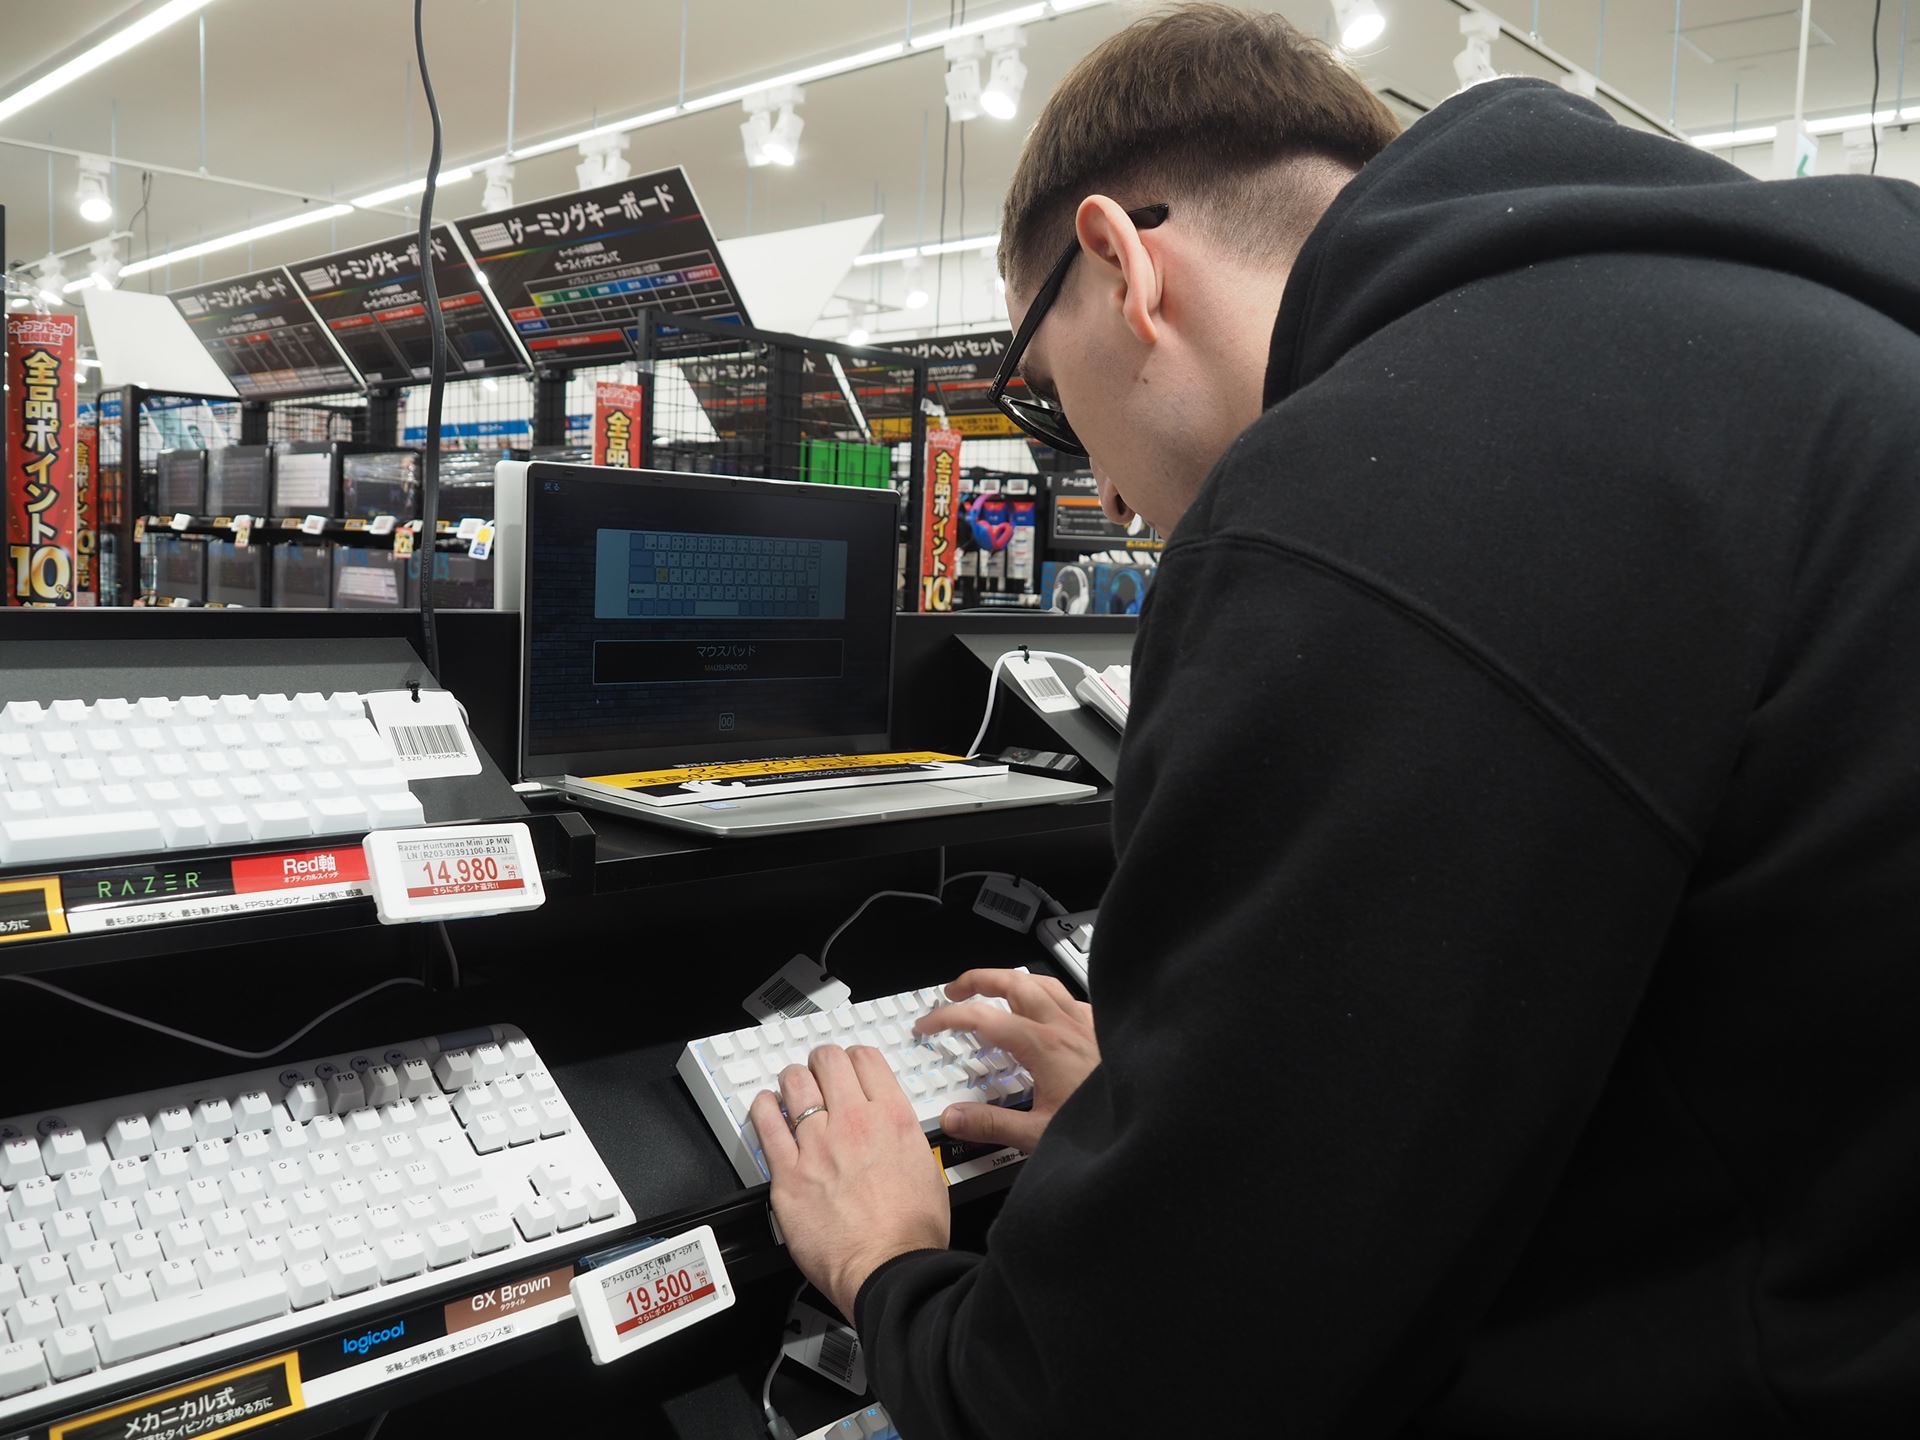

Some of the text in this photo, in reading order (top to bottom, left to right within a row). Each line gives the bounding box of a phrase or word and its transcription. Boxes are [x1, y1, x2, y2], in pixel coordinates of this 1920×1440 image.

[507, 183, 675, 244] ゲーミングキーボード
[327, 237, 447, 286] ゲーミングキーボド
[8, 320, 73, 336] オープンセール
[24, 350, 60, 545] 全品ポイント
[932, 450, 954, 577] 全品ポイント
[696, 644, 758, 657] マウスパッド
[398, 836, 511, 853] Razer Huntsman Mini JP MW
[406, 852, 418, 860] LN
[283, 853, 337, 875] Red軸
[423, 856, 499, 886] 14,980
[283, 871, 339, 884] オプティカルスイッチ
[97, 872, 201, 899] RAZER
[406, 1059, 424, 1068] F12
[372, 1066, 389, 1075] F11
[336, 1073, 355, 1083] F10
[303, 1081, 316, 1089] F9
[468, 1084, 481, 1092] INS
[246, 1092, 260, 1100] F8
[207, 1101, 220, 1109] F7
[167, 1108, 181, 1117] F6
[124, 1117, 139, 1126] F5
[203, 1143, 210, 1151] 8
[161, 1152, 168, 1160] 7
[318, 1152, 325, 1160] P
[117, 1162, 125, 1170] 6
[69, 1171, 78, 1180] 5
[26, 1182, 34, 1190] 4
[197, 1181, 206, 1189] U
[452, 1183, 476, 1194] SHIFT
[155, 1191, 163, 1199] Y
[111, 1200, 120, 1209] T
[262, 1201, 272, 1209] K
[65, 1211, 75, 1221] R
[224, 1212, 230, 1220] J
[19, 1222, 26, 1232] E
[178, 1222, 189, 1230] H
[134, 1233, 144, 1242] G
[255, 1239, 266, 1247] M
[90, 1243, 97, 1253] F
[40, 1256, 51, 1265] D
[171, 1261, 180, 1270] B
[624, 1261, 655, 1280] G713-TC
[123, 1273, 134, 1281] V
[78, 1285, 88, 1294] C
[471, 1275, 551, 1312] GX Brown
[626, 1269, 692, 1315] 19,500
[29, 1298, 39, 1308] X
[499, 1297, 526, 1312] タクタイル
[343, 1320, 405, 1356] logicool
[123, 1386, 237, 1439] メカニカル式
